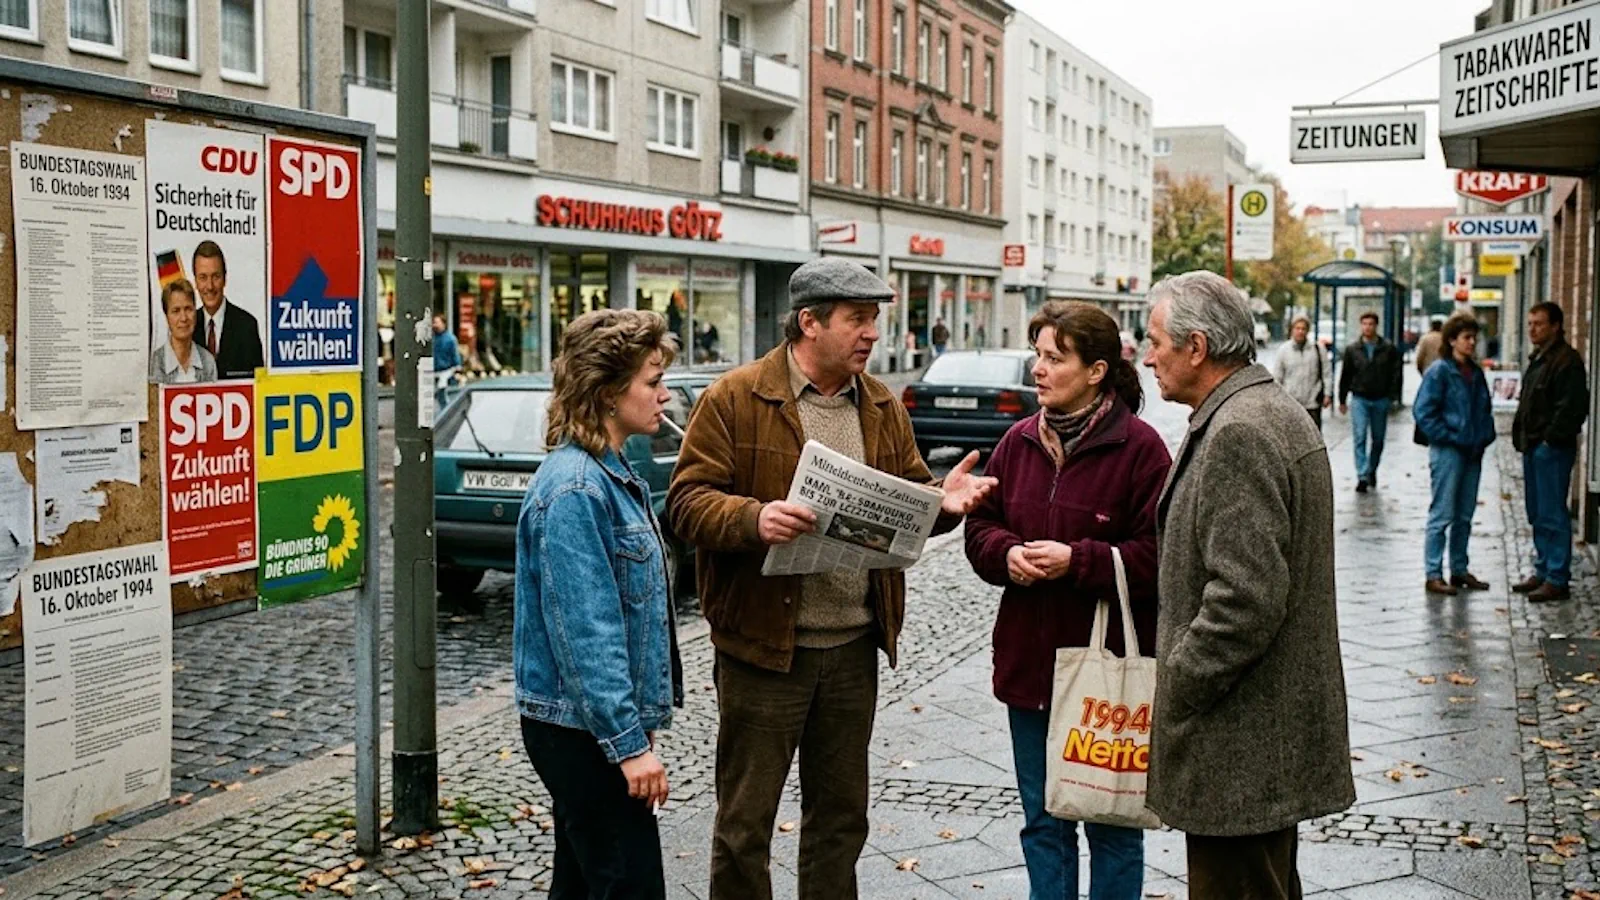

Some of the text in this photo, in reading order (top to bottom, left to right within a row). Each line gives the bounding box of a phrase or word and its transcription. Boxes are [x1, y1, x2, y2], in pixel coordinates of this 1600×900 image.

[1454, 18, 1591, 82] TABAKWAREN
[1297, 122, 1418, 150] ZEITUNGEN
[20, 153, 138, 181] BUNDESTAGSWAHL
[201, 146, 257, 176] CDU
[279, 147, 350, 200] SPD
[30, 176, 131, 201] 16. Oktober 1934
[1461, 171, 1538, 191] KRAFT
[155, 183, 257, 212] Sicherheit für
[156, 210, 257, 236] Deutschland!
[535, 194, 723, 242] SCHUHHAUS GÖTZ
[1448, 219, 1537, 236] KONSUM
[278, 301, 353, 330] Zukunft
[278, 334, 353, 362] wählen!
[169, 392, 250, 447] SPD
[265, 392, 355, 456] FDP
[171, 446, 251, 481] Zukunft
[172, 477, 251, 513] wählen!
[266, 538, 314, 561] BÜNDNIS
[314, 534, 330, 552] 90
[33, 554, 159, 593] BUNDESTAGSWAHL
[265, 560, 285, 579] DIE
[40, 596, 62, 616] 16.
[65, 587, 119, 612] Oktober
[122, 578, 154, 601] 1994
[1080, 697, 1152, 735] 1994
